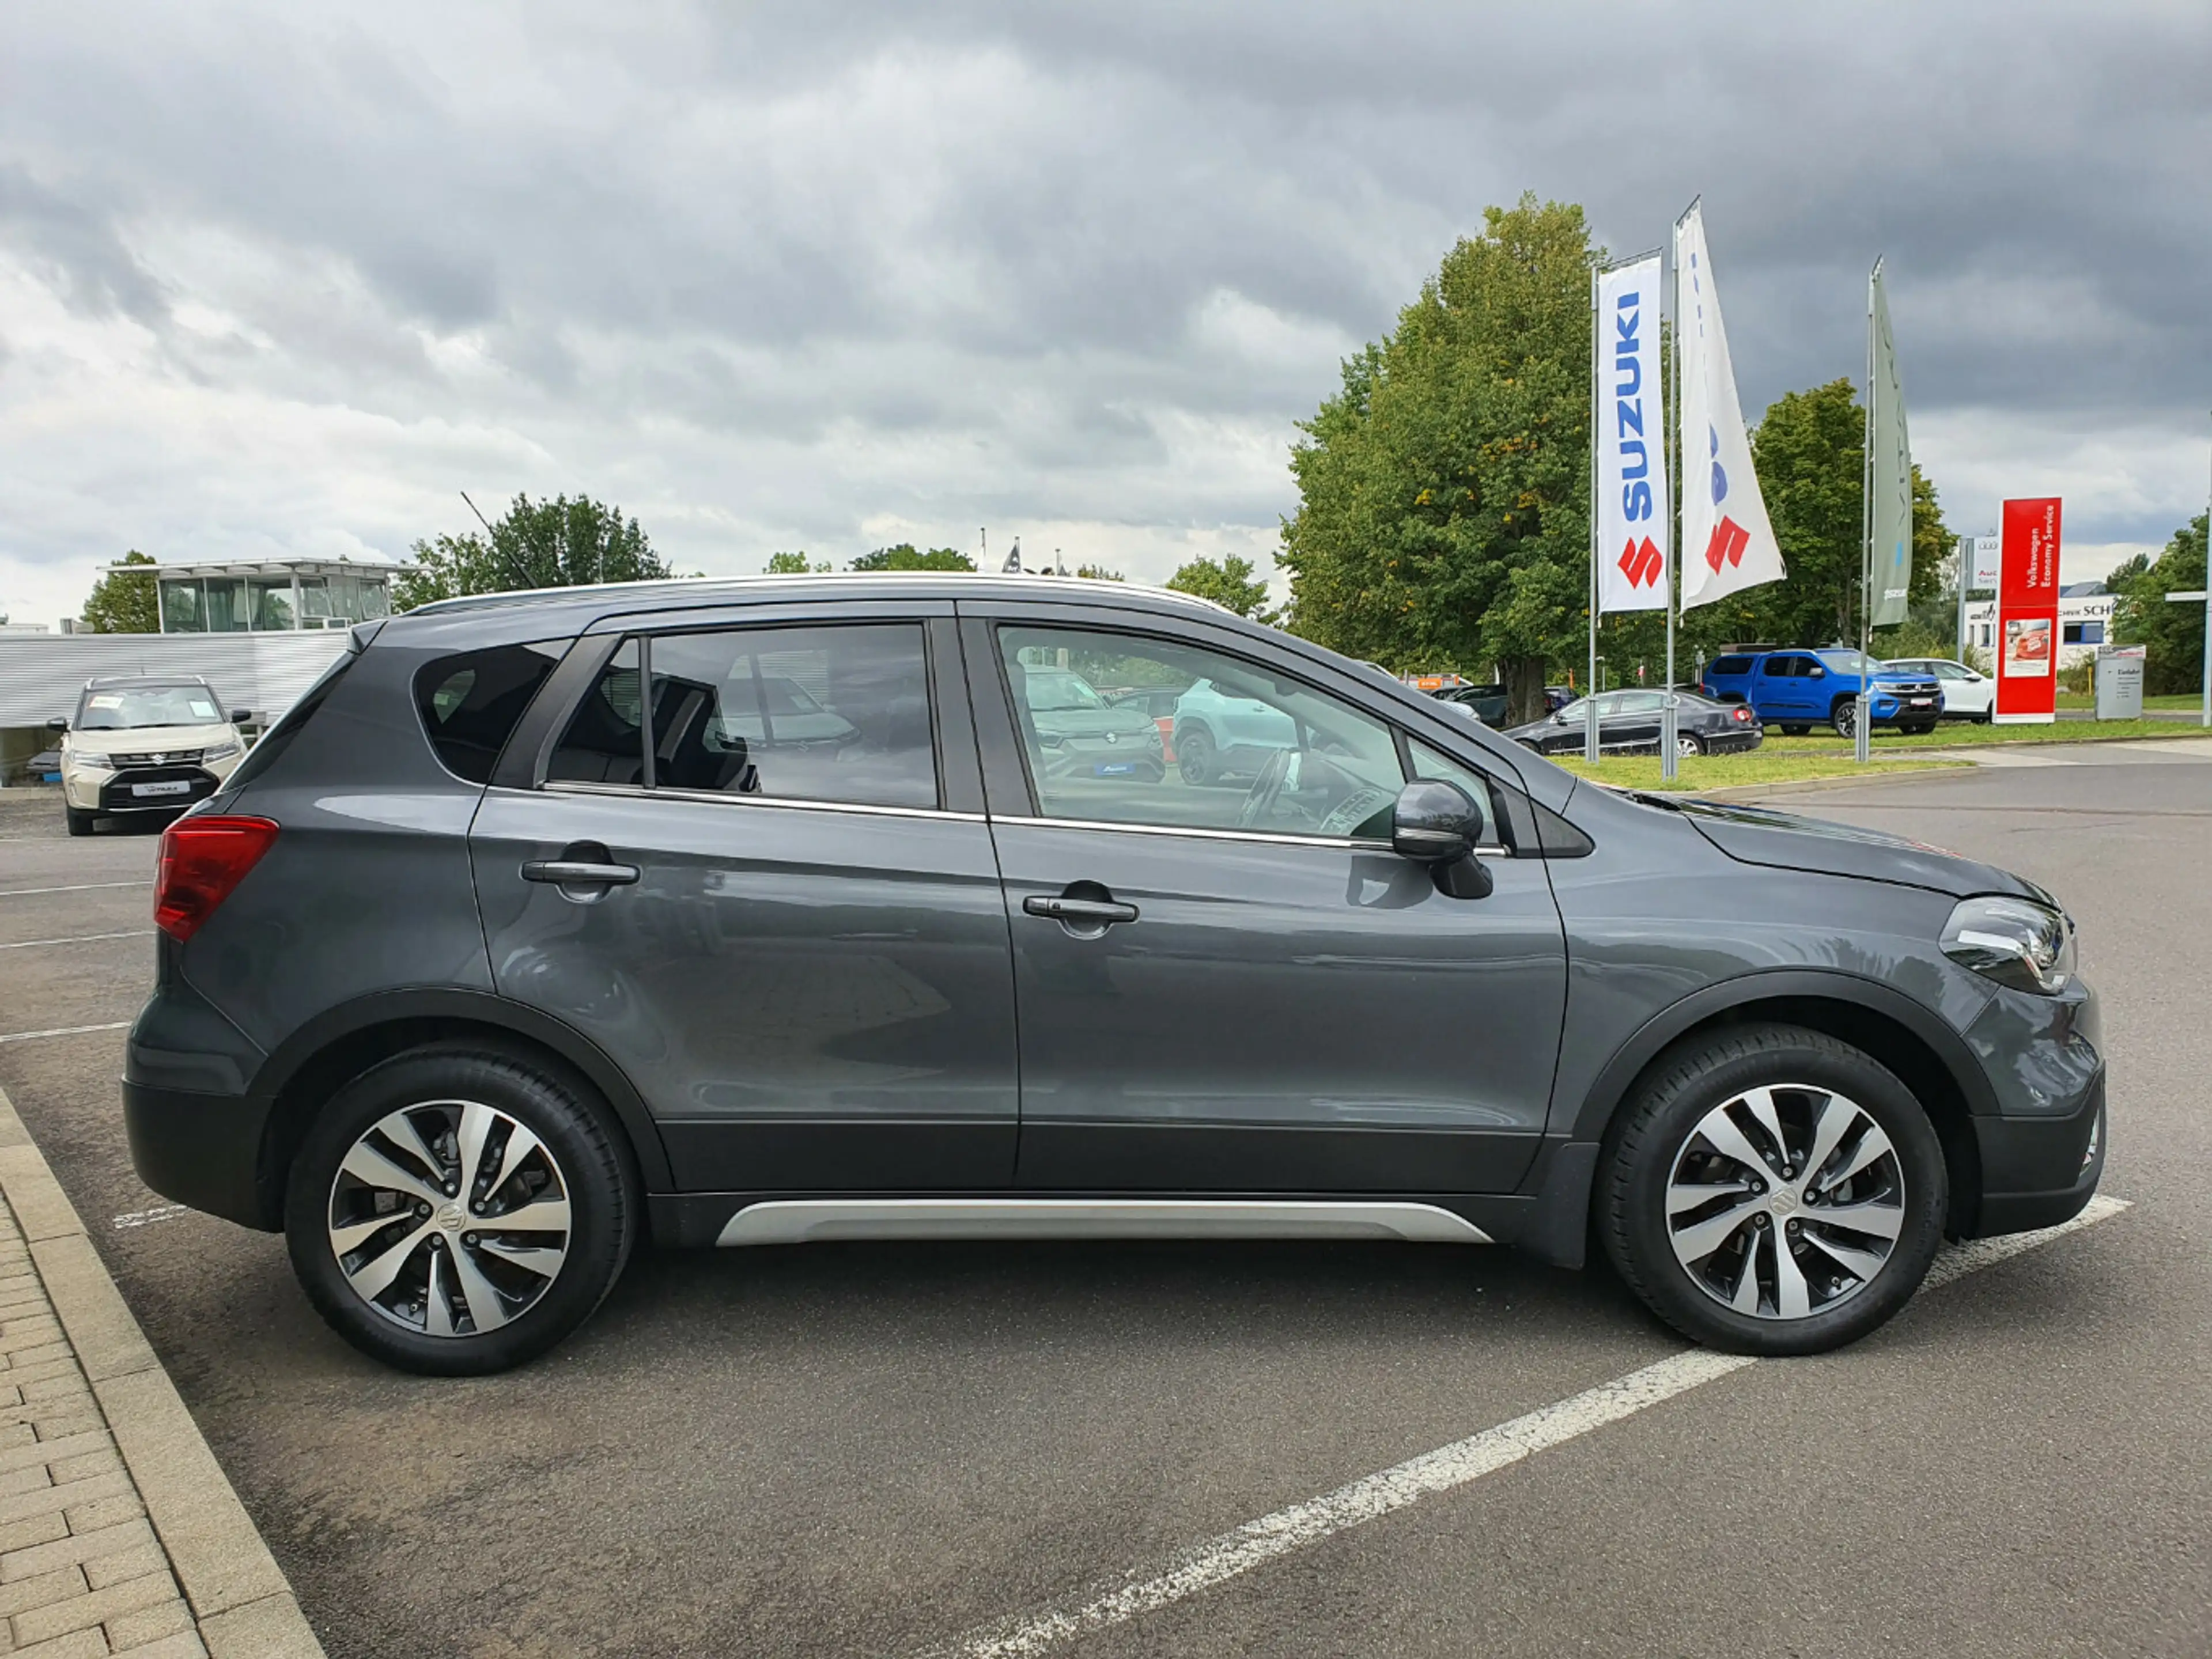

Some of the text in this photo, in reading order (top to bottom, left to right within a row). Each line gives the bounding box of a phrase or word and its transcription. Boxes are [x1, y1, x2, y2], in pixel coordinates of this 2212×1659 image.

[1616, 291, 1653, 522] SUZUKI
[2026, 528, 2041, 588] Volkswagen
[2040, 505, 2055, 588] Economy Service
